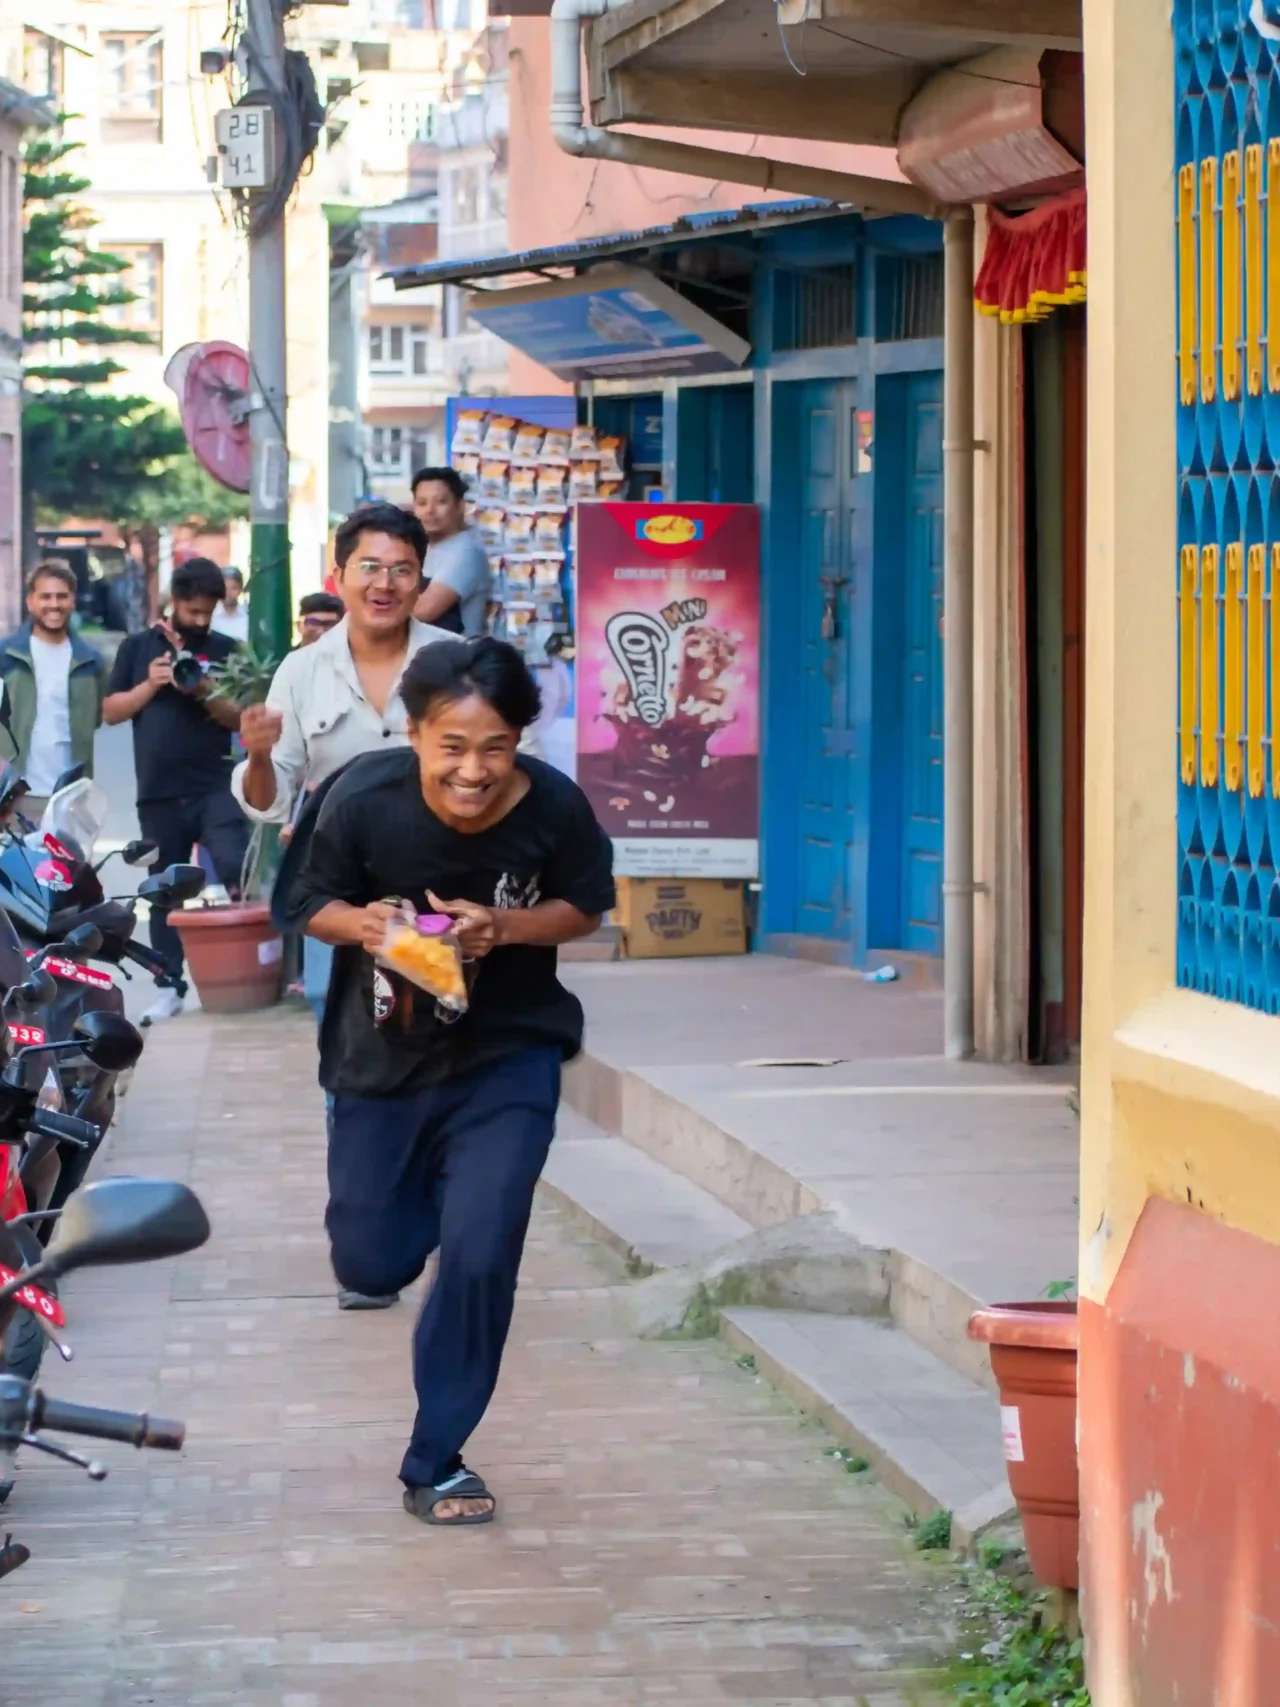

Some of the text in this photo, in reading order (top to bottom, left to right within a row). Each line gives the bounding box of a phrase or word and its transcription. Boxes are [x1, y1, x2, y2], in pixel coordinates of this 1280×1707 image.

[229, 113, 259, 139] 28
[228, 153, 257, 176] 41
[660, 598, 707, 631] MINI
[606, 612, 669, 724] Cornetto
[645, 909, 702, 932] PARTY
